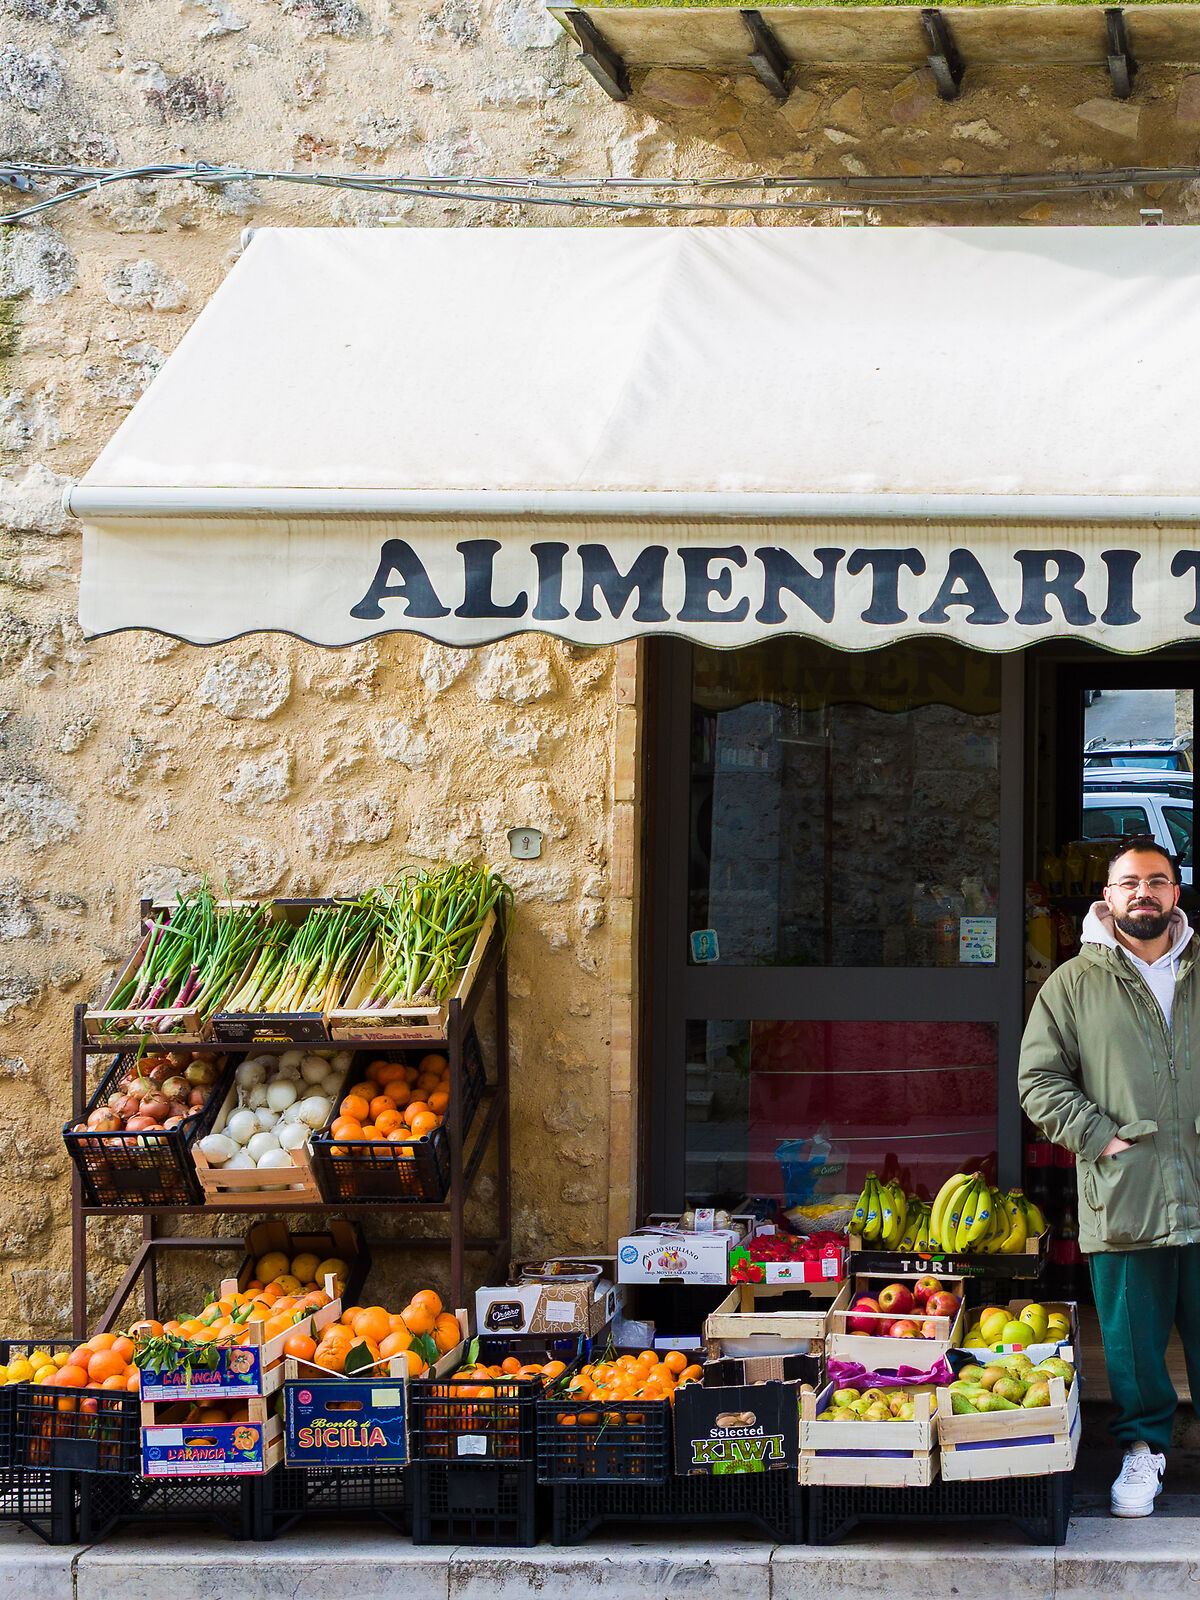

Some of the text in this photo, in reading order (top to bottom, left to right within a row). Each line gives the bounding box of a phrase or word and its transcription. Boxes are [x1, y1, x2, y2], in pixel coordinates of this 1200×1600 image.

[350, 538, 1141, 629] ALIMENTARI
[900, 1260, 954, 1273] TURI
[360, 1419, 372, 1428] di
[298, 1427, 388, 1448] SICILIA
[709, 1426, 764, 1438] Selected
[167, 1447, 226, 1461] L'ARANCIA
[690, 1434, 786, 1464] KIWI
